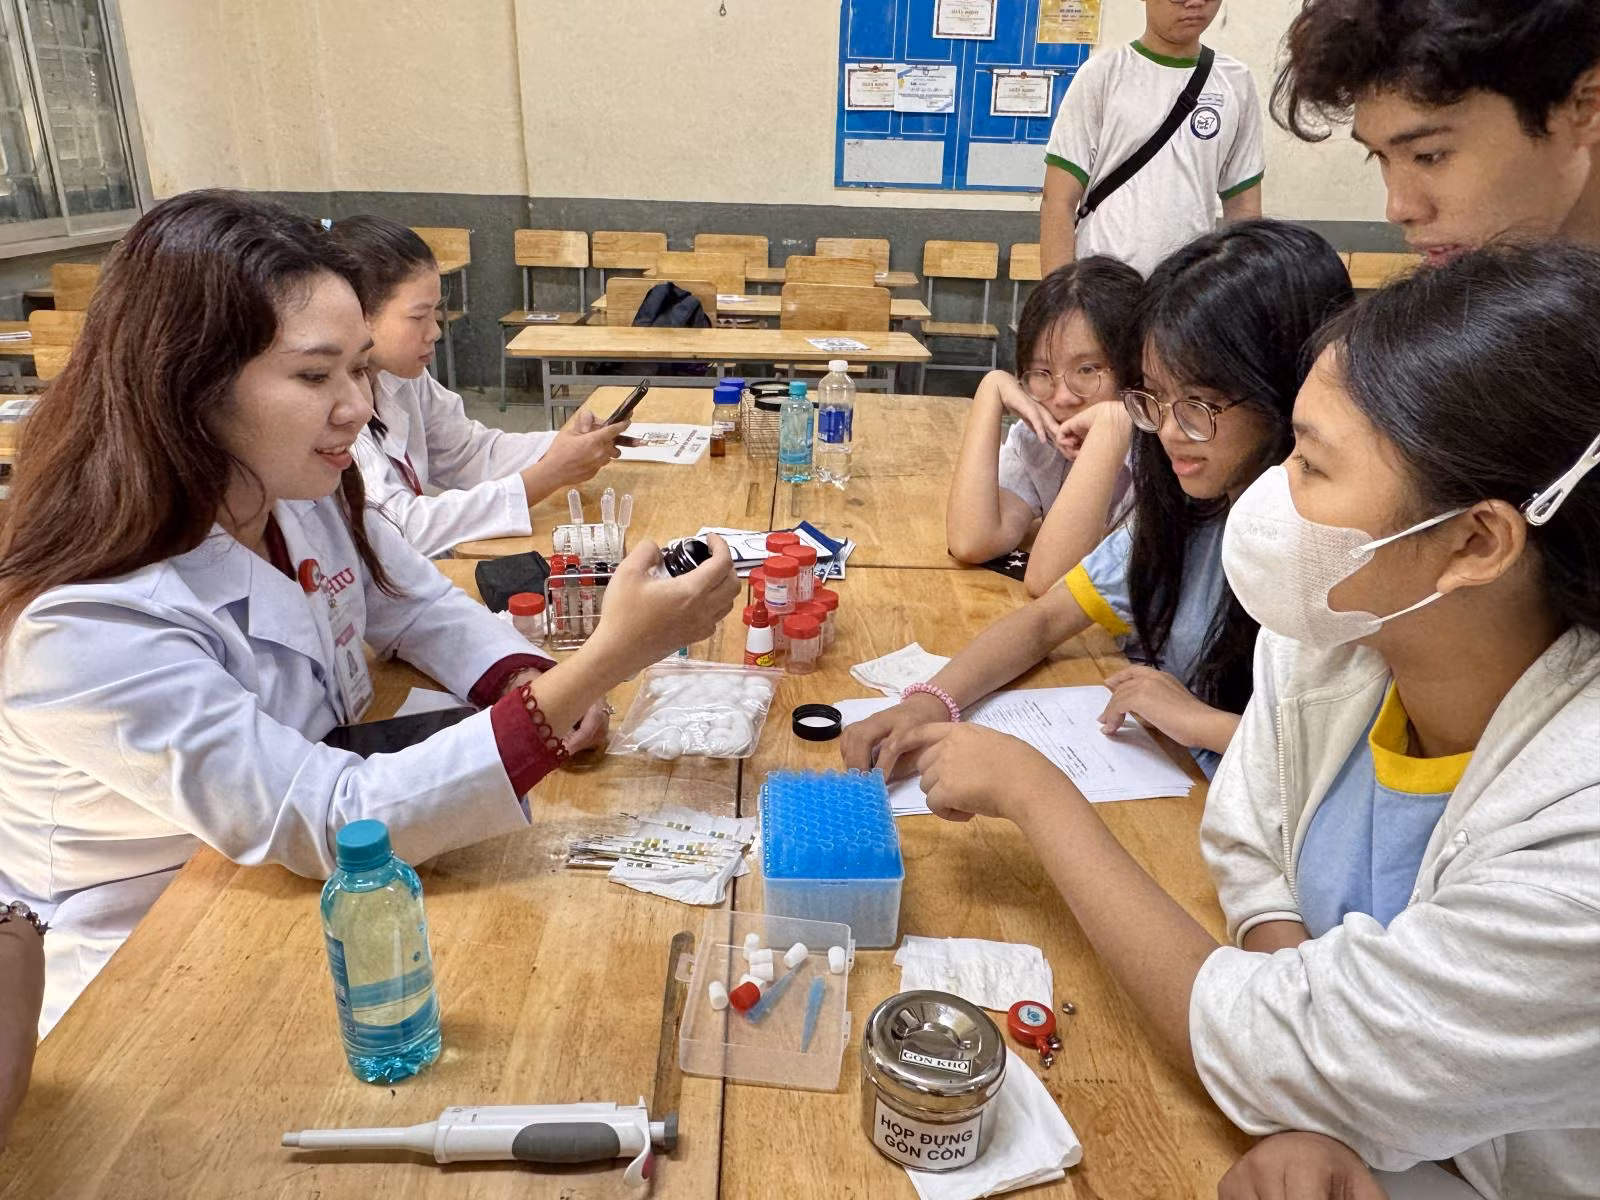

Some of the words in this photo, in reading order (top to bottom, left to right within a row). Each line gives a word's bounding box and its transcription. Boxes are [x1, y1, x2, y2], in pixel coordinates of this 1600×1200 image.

[881, 1114, 915, 1139] HỘP
[920, 1130, 973, 1148] ĐỰNG
[885, 1134, 921, 1158] GÒN
